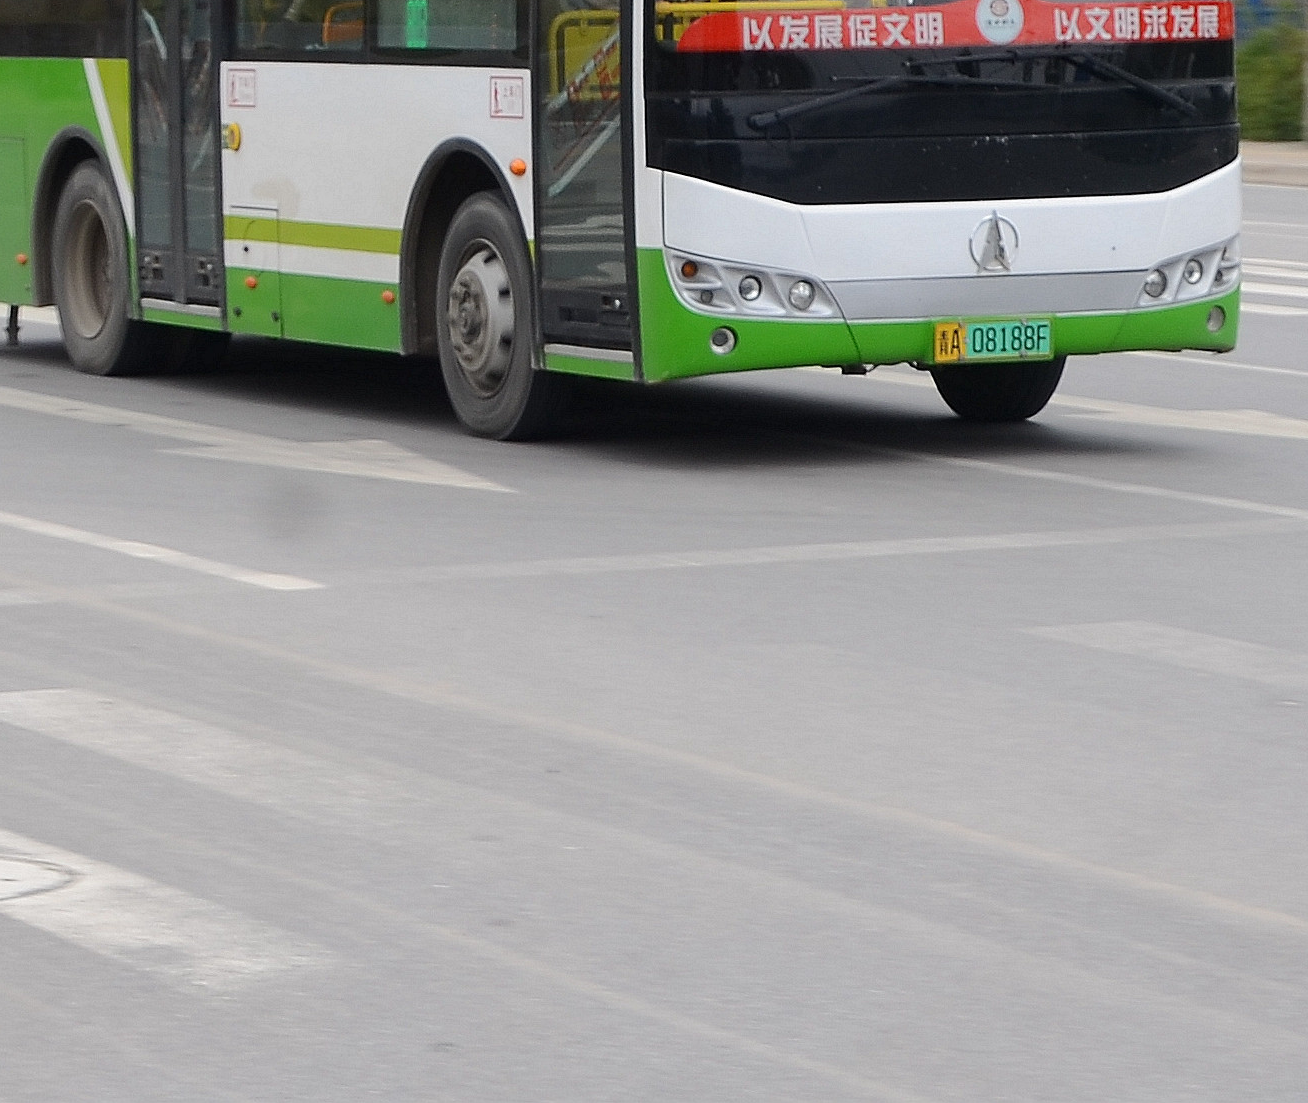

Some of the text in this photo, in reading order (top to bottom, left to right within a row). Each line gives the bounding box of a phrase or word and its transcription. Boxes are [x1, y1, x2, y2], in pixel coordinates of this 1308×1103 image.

[743, 5, 1219, 50] 以发展促文明 以文明求发展
